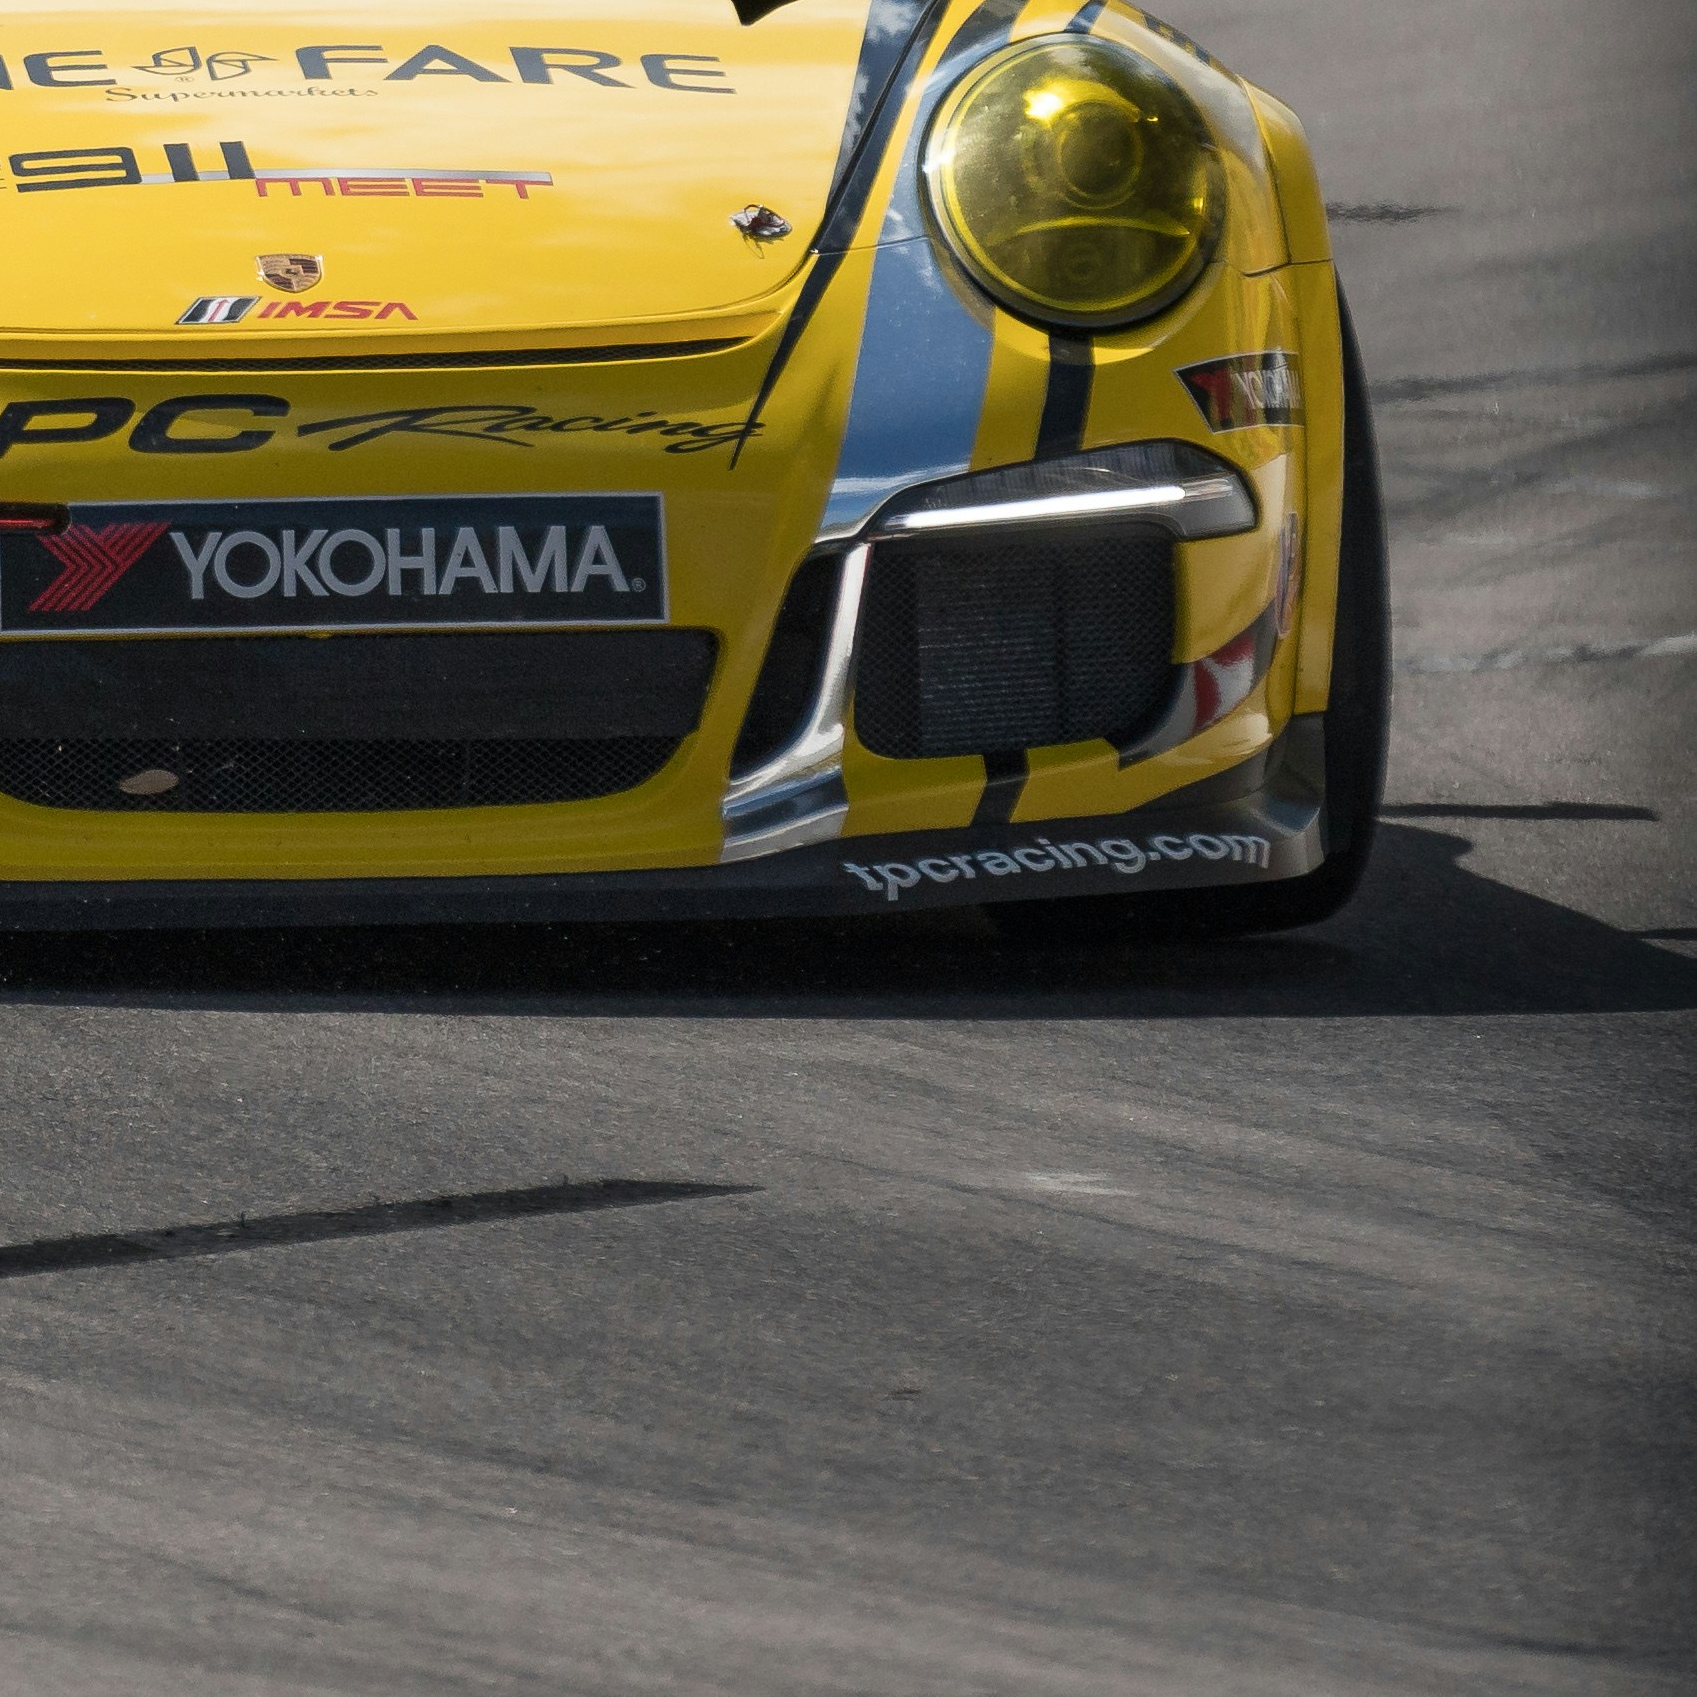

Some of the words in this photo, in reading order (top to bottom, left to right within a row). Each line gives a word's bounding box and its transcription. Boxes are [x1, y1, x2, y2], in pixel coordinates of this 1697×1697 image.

[106, 85, 380, 103] Supermarkets
[295, 44, 737, 95] FARE
[8, 140, 256, 193] 911
[257, 300, 419, 320] IMSA
[297, 404, 766, 454] Racing
[171, 524, 628, 600] YOKOHAMA
[843, 832, 1271, 902] tpcracing.com
